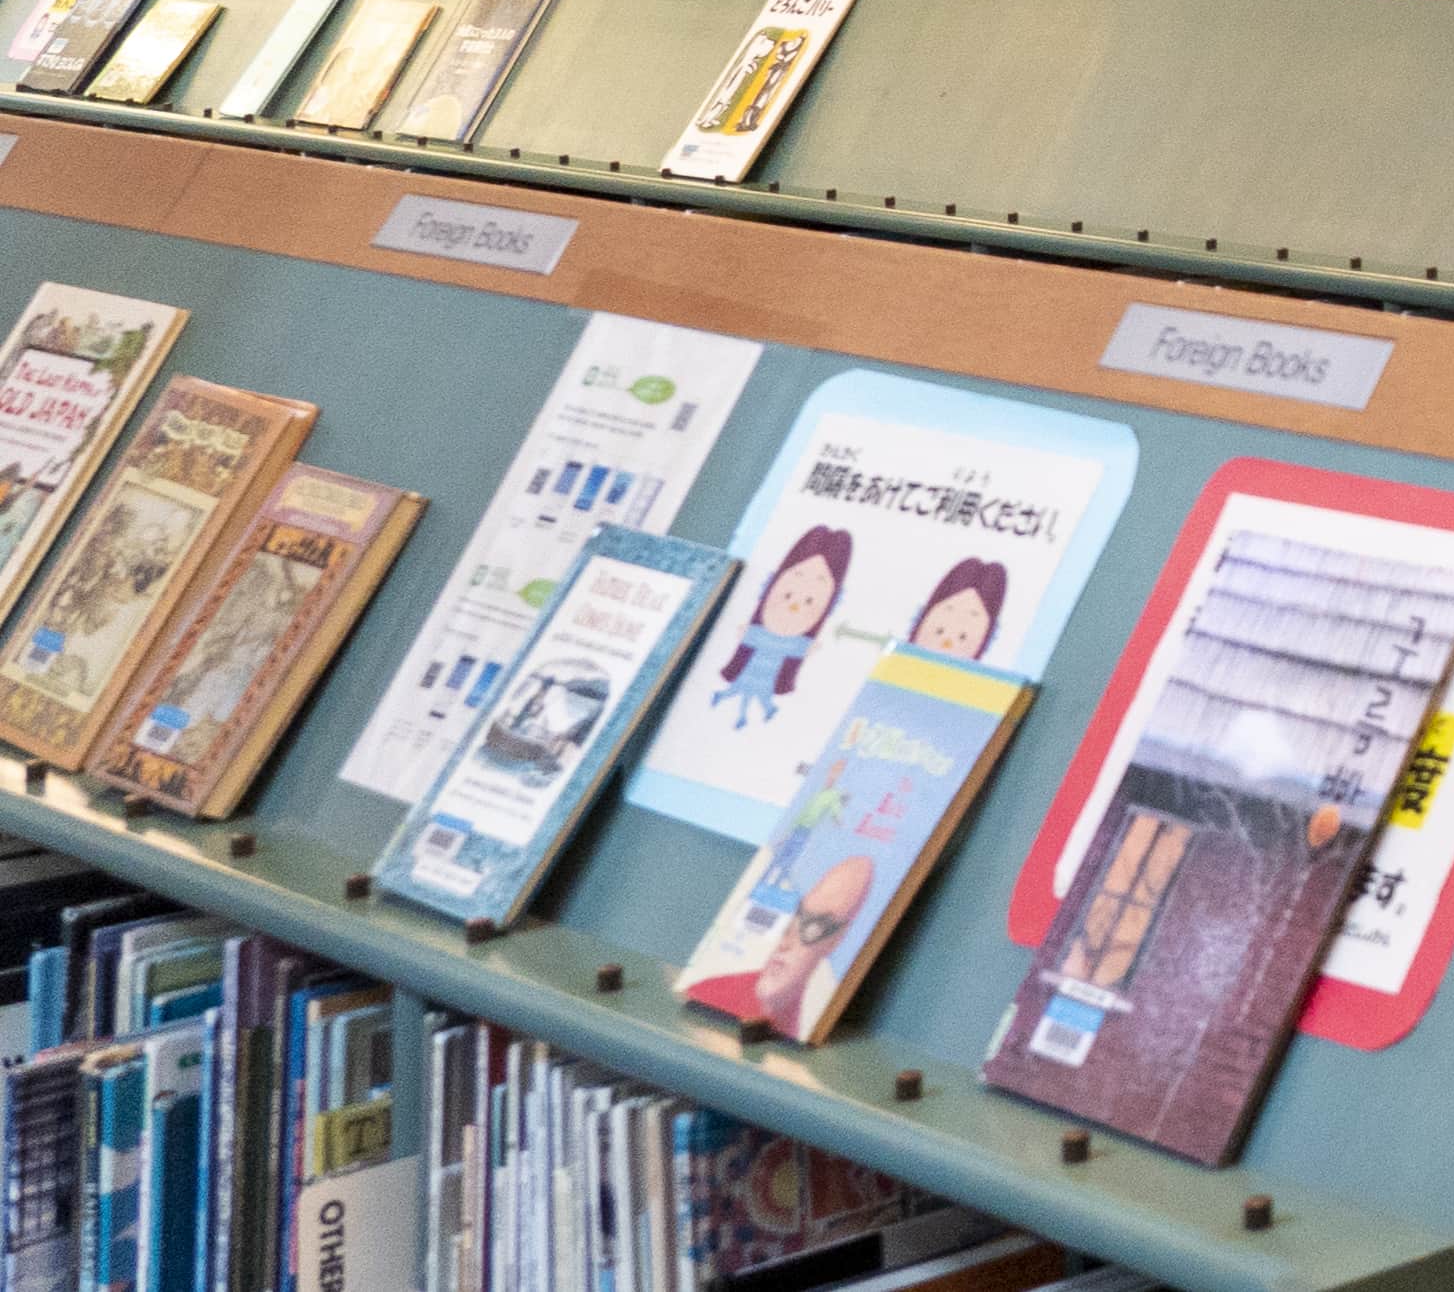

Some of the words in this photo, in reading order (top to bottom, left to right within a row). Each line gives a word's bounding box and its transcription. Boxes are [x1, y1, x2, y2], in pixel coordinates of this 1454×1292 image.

[410, 204, 474, 247] Foreign
[475, 222, 534, 256] Books
[1148, 326, 1245, 376] Foreign
[1245, 338, 1331, 386] Books
[800, 459, 1063, 545] 間隔をあけてご利用ください。
